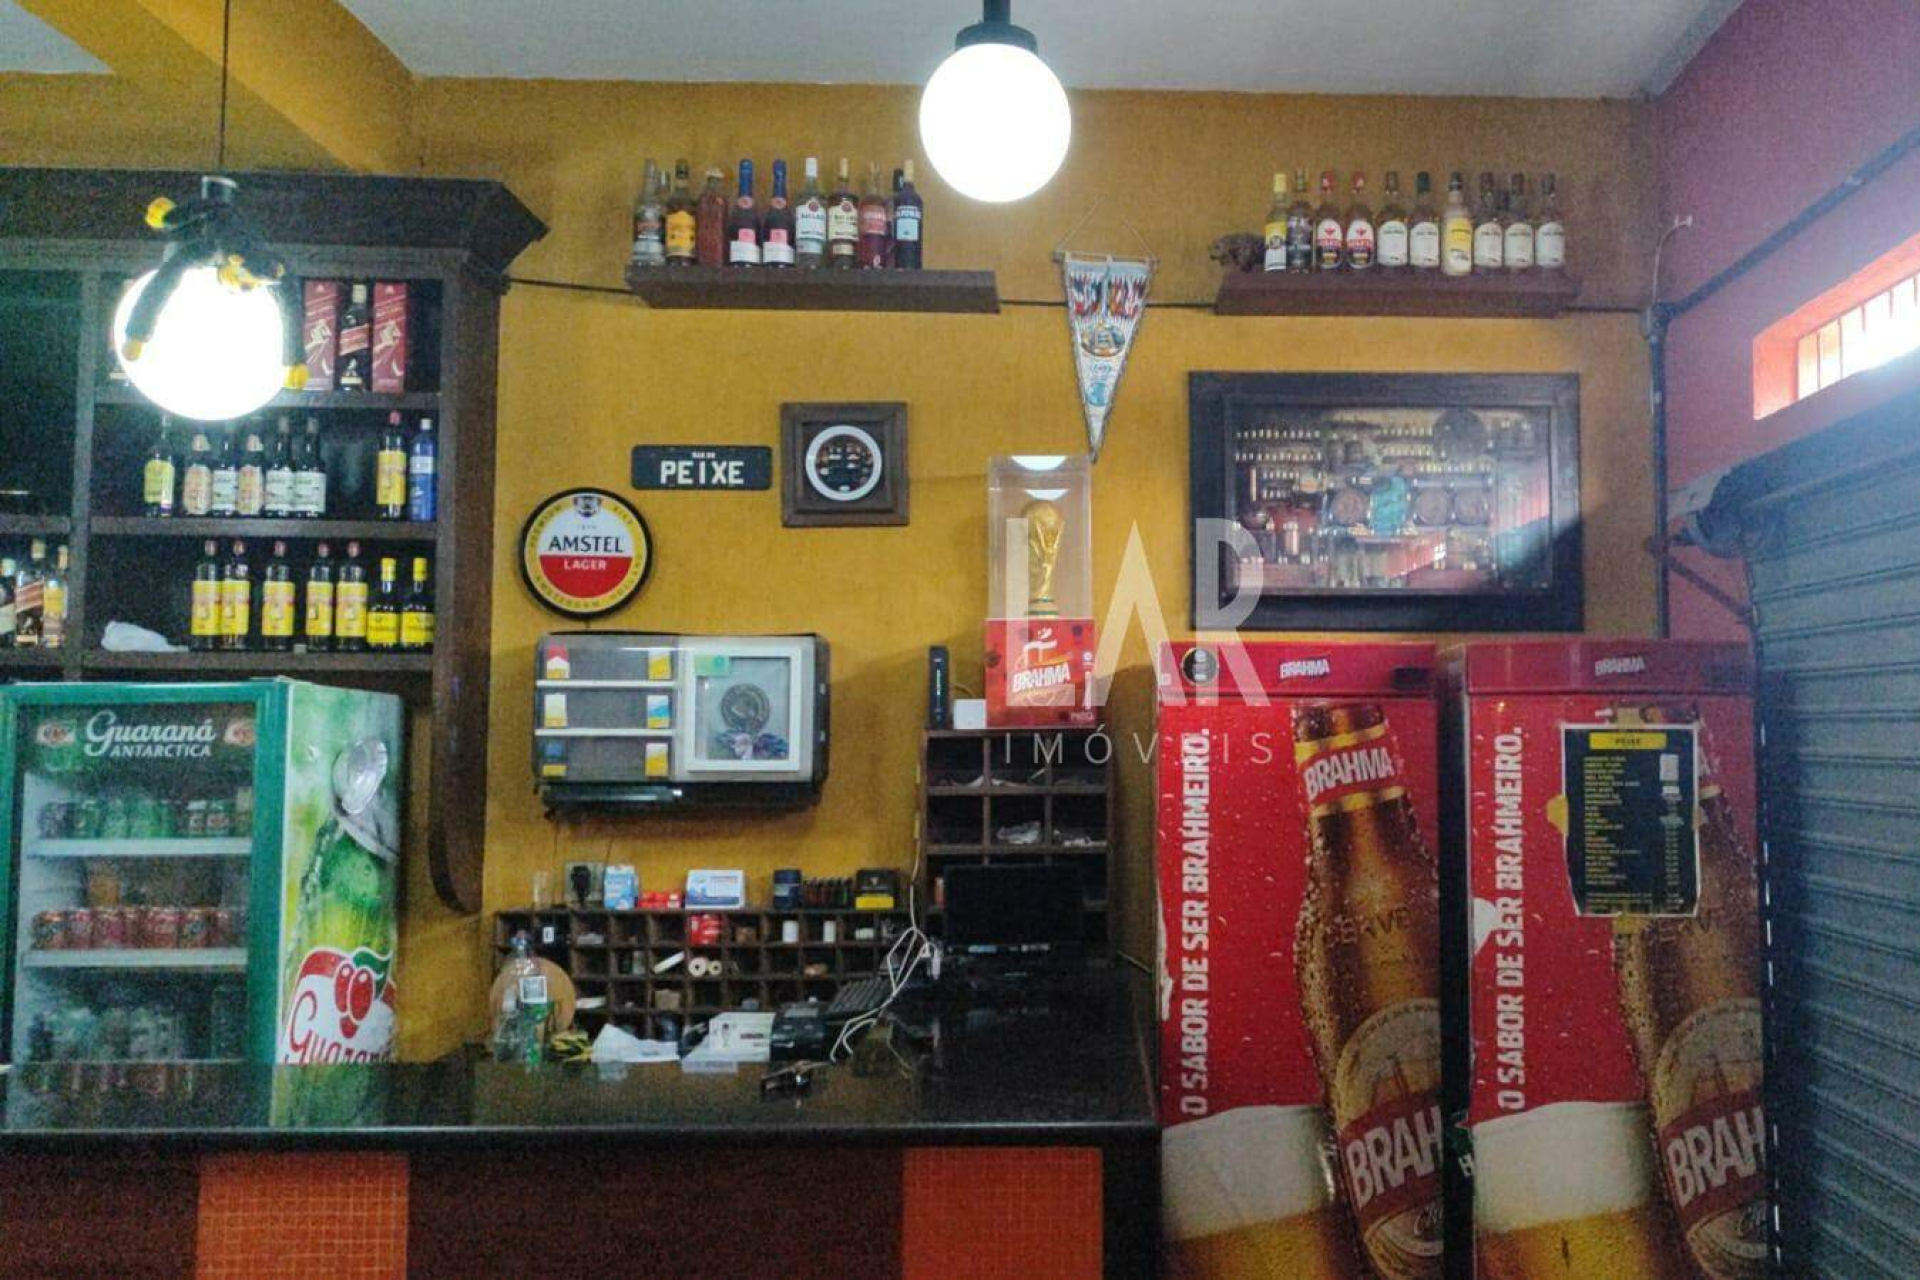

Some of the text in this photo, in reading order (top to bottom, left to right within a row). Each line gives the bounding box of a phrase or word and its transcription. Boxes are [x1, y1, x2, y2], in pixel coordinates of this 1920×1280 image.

[660, 460, 744, 484] PEIXE
[548, 535, 624, 553] AMSTEL
[564, 559, 607, 571] LAGER
[1012, 662, 1071, 693] BRAHMA
[1279, 658, 1331, 680] BRAHMA
[1595, 656, 1646, 676] BRAHMA
[84, 709, 216, 757] Guaraná
[110, 744, 212, 758] ANTARCTICA
[1304, 746, 1395, 803] BRAHMA
[1181, 728, 1209, 1115] O SABOR DE SER BRAHMEIRO.
[1495, 726, 1524, 1110] O SABOR DE SER BRAHMEIRO.
